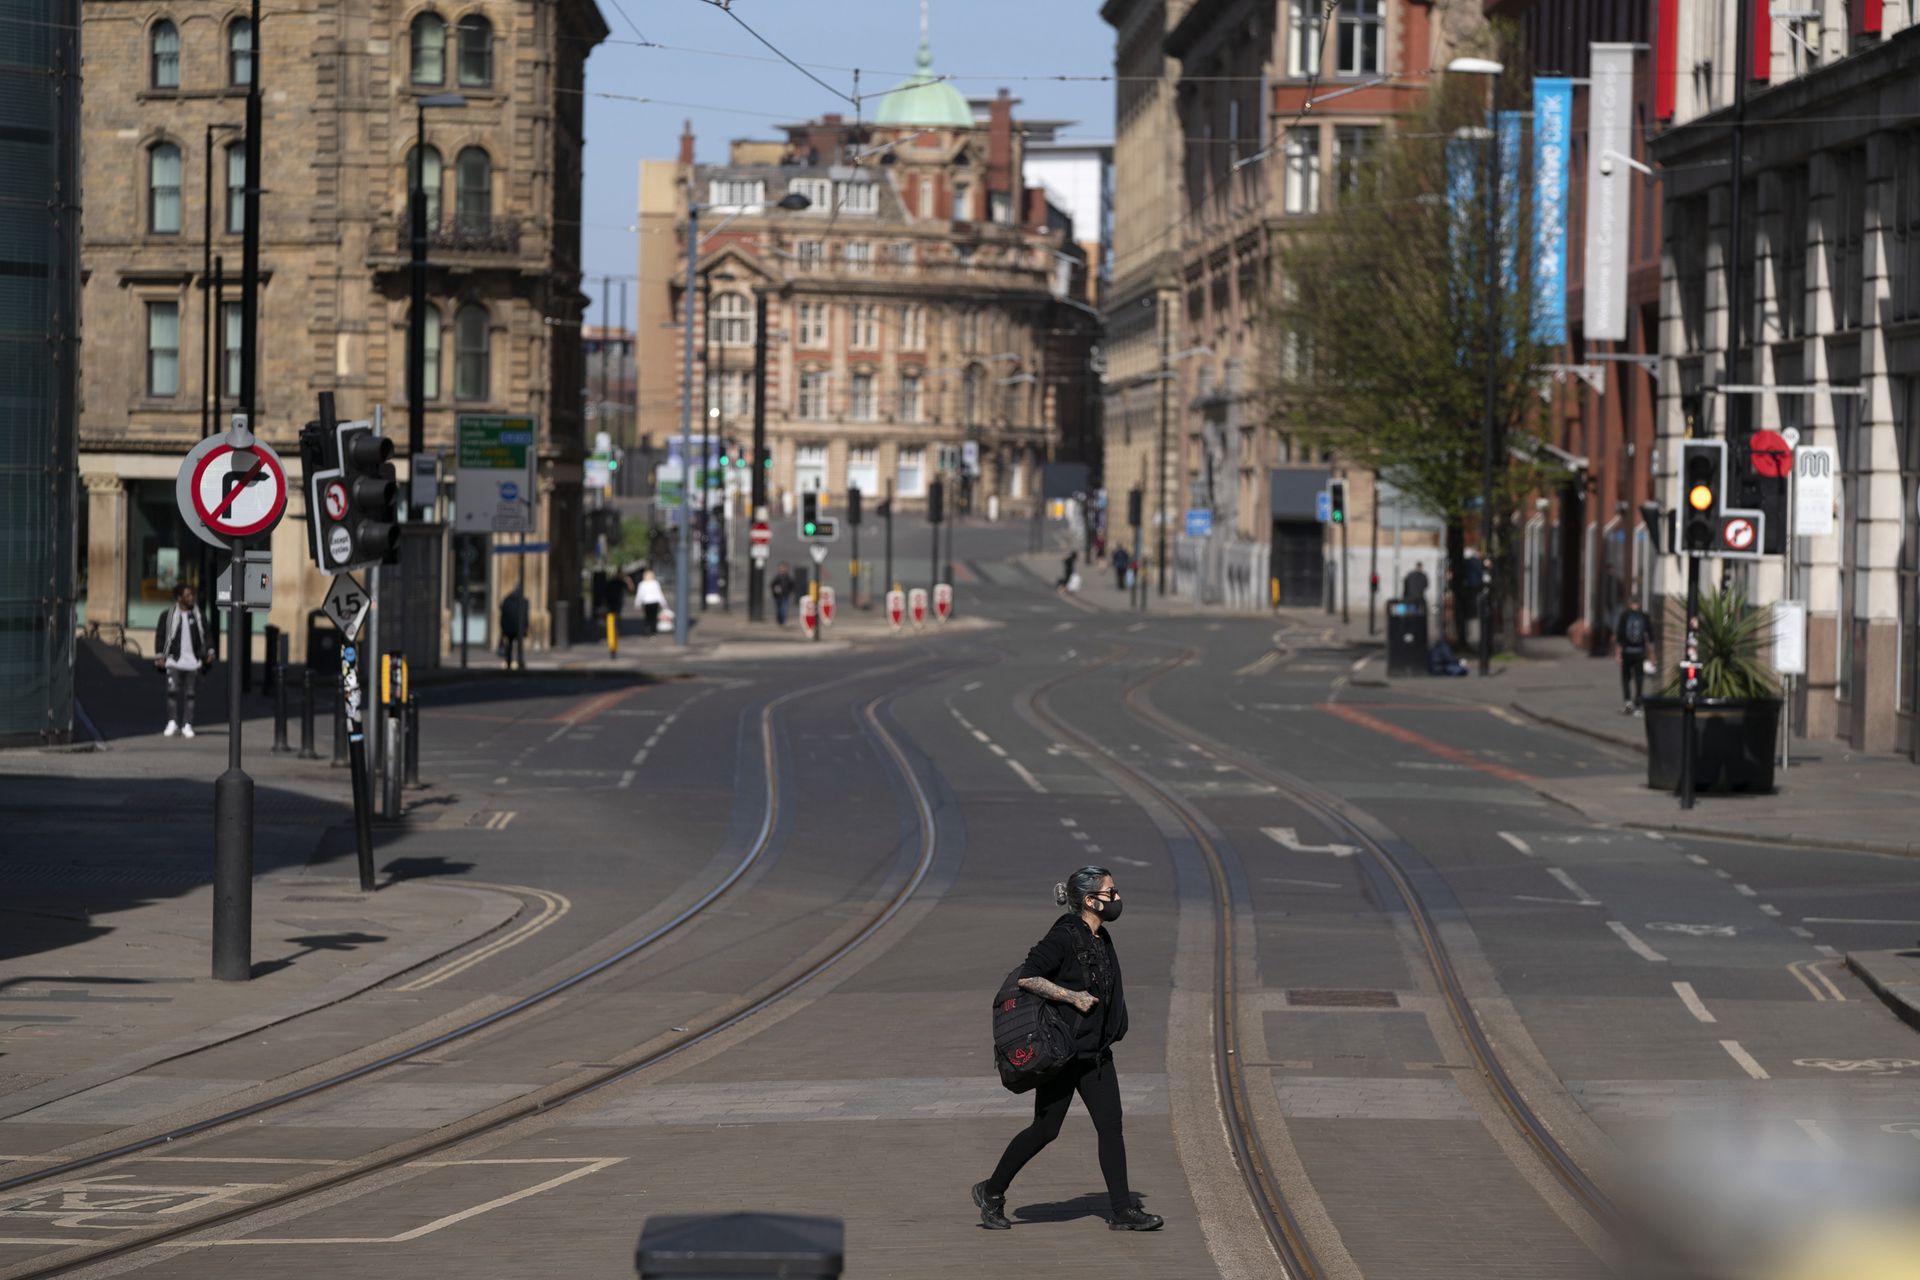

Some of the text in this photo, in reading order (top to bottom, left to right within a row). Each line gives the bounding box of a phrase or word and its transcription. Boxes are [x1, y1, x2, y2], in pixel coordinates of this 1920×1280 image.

[1540, 95, 1562, 143] bank
[332, 545, 349, 555] cycles
[332, 593, 361, 617] 15
